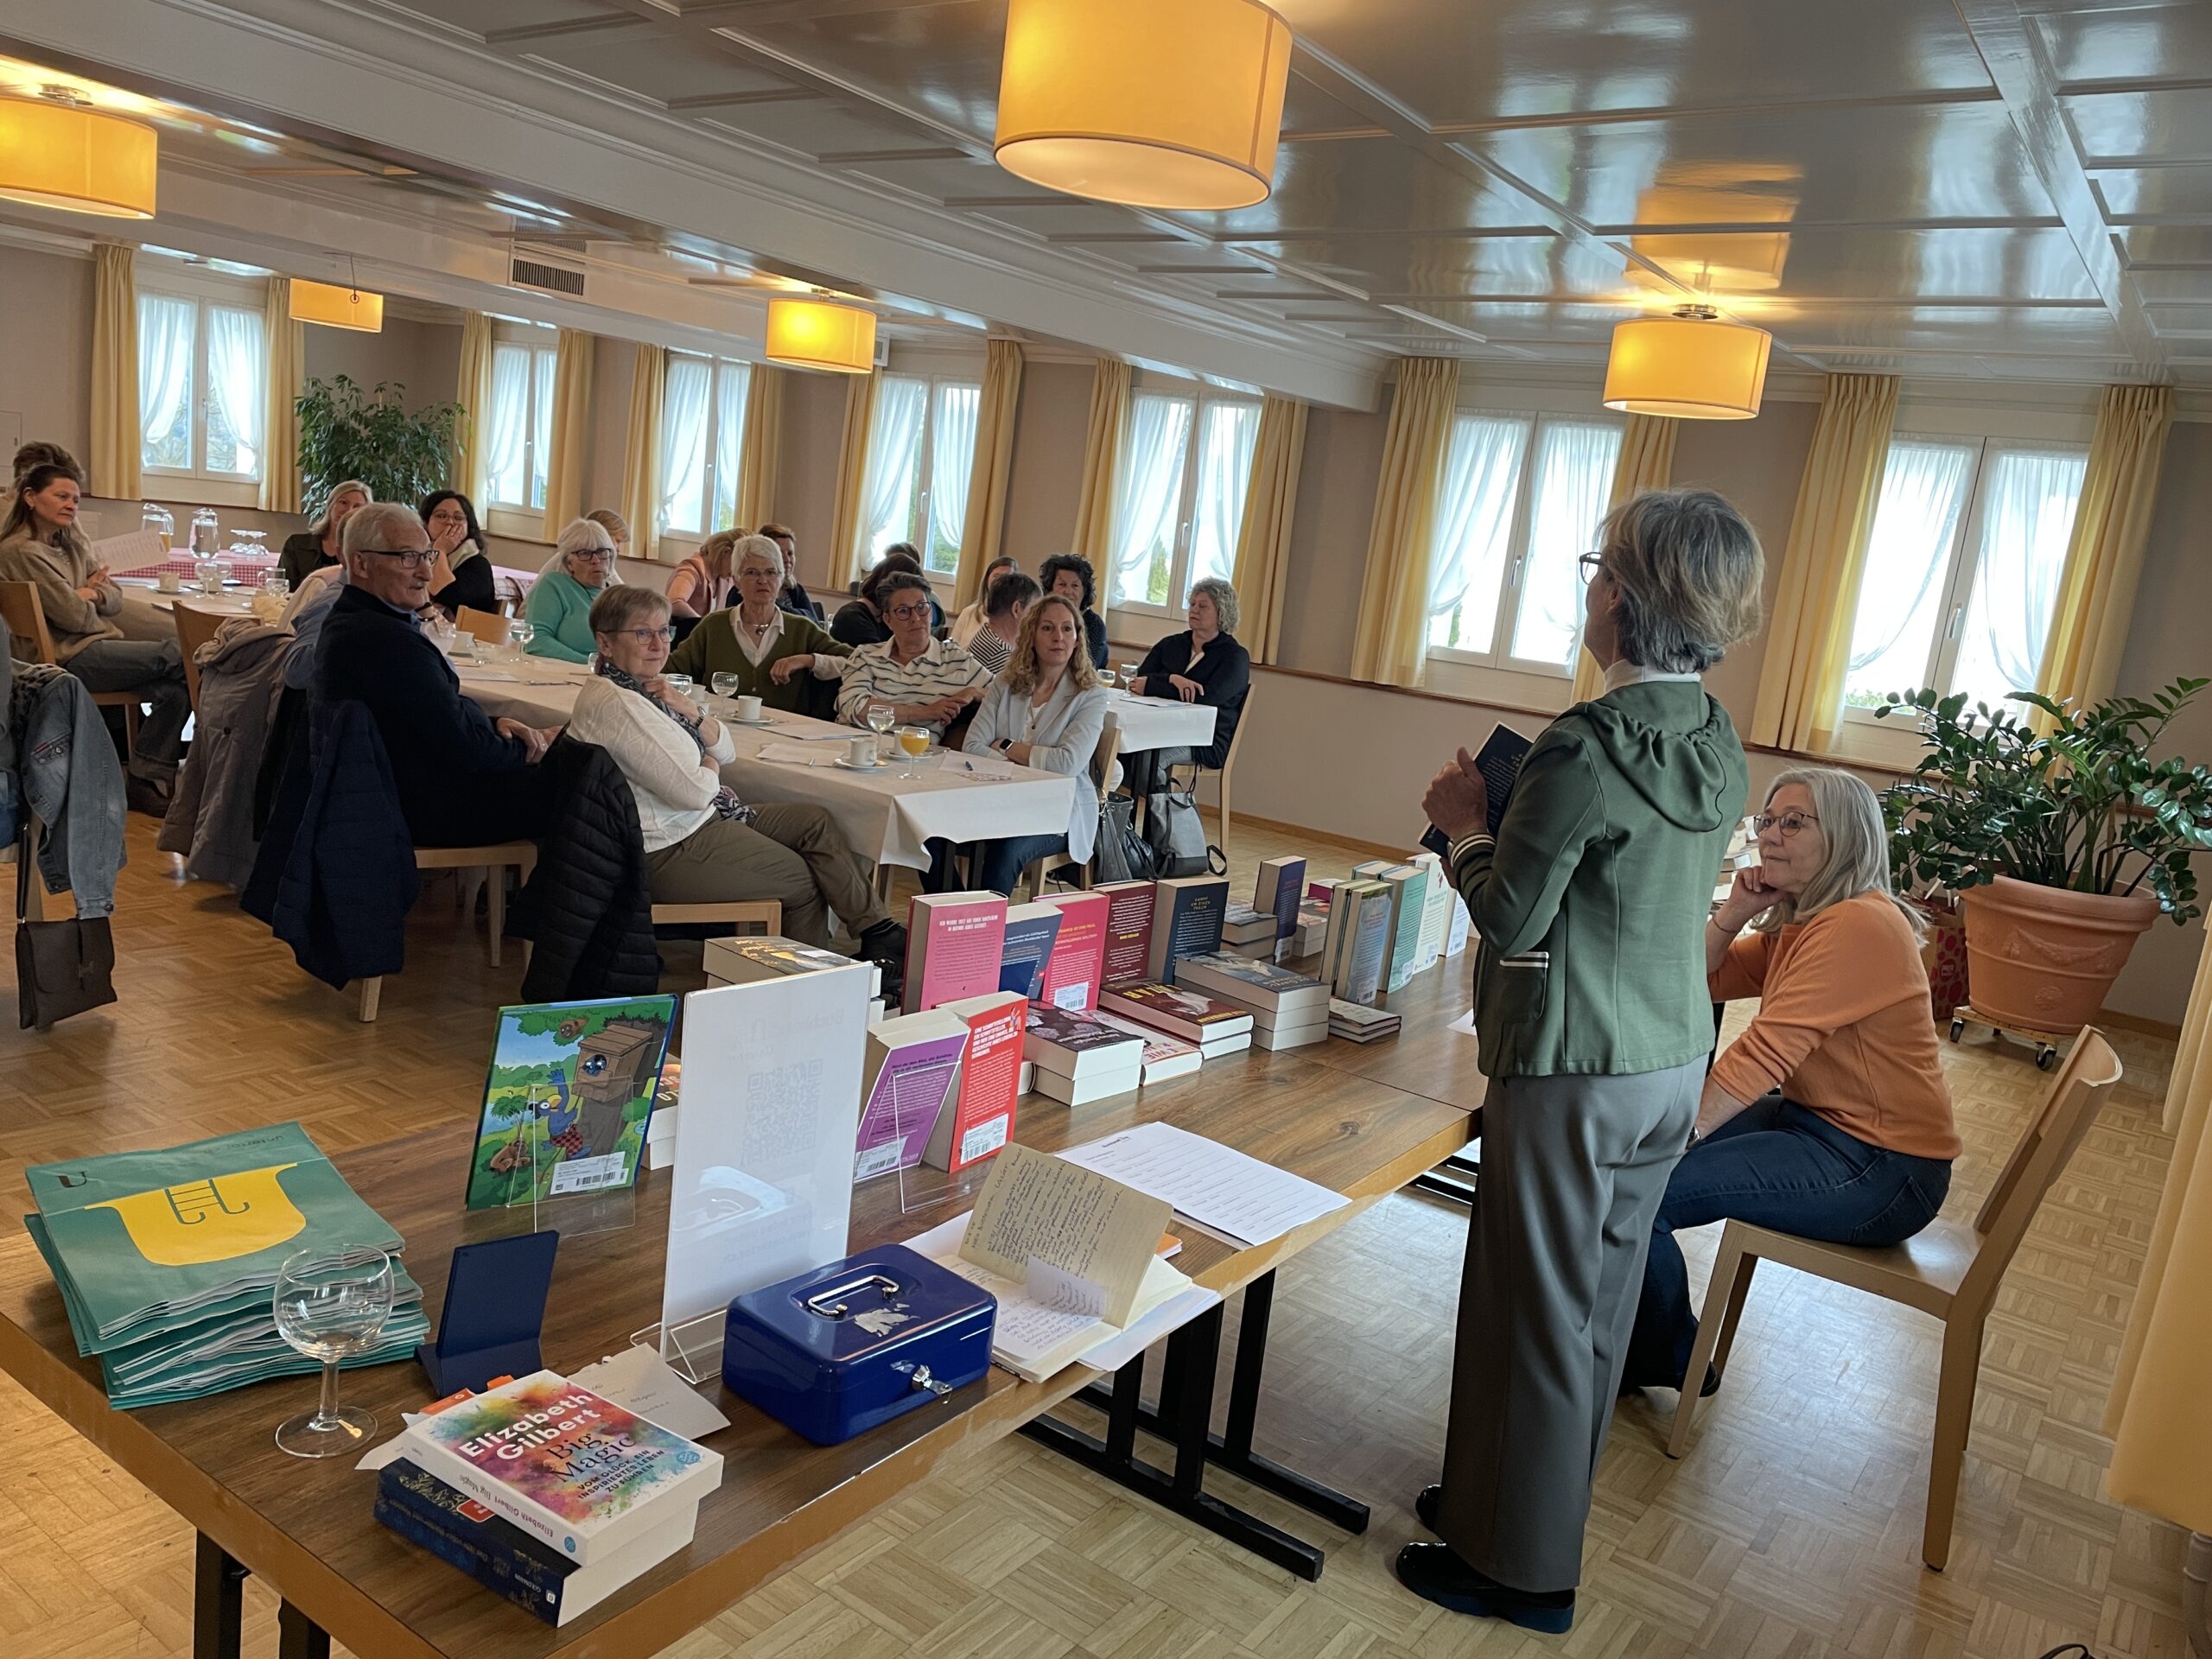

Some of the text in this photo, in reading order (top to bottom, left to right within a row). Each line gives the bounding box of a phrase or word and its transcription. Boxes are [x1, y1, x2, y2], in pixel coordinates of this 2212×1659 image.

[458, 1395, 594, 1459] Elizabeth
[496, 1408, 601, 1460] Gilbert
[546, 1432, 602, 1460] Big
[551, 1433, 636, 1483] Magic
[577, 1476, 601, 1491] VOM
[635, 1450, 650, 1460] EIN
[578, 1450, 664, 1499] INSPIRIERTES LEBEN
[606, 1464, 655, 1493] ZU FÜHREN
[520, 1513, 554, 1538] Elizabeth
